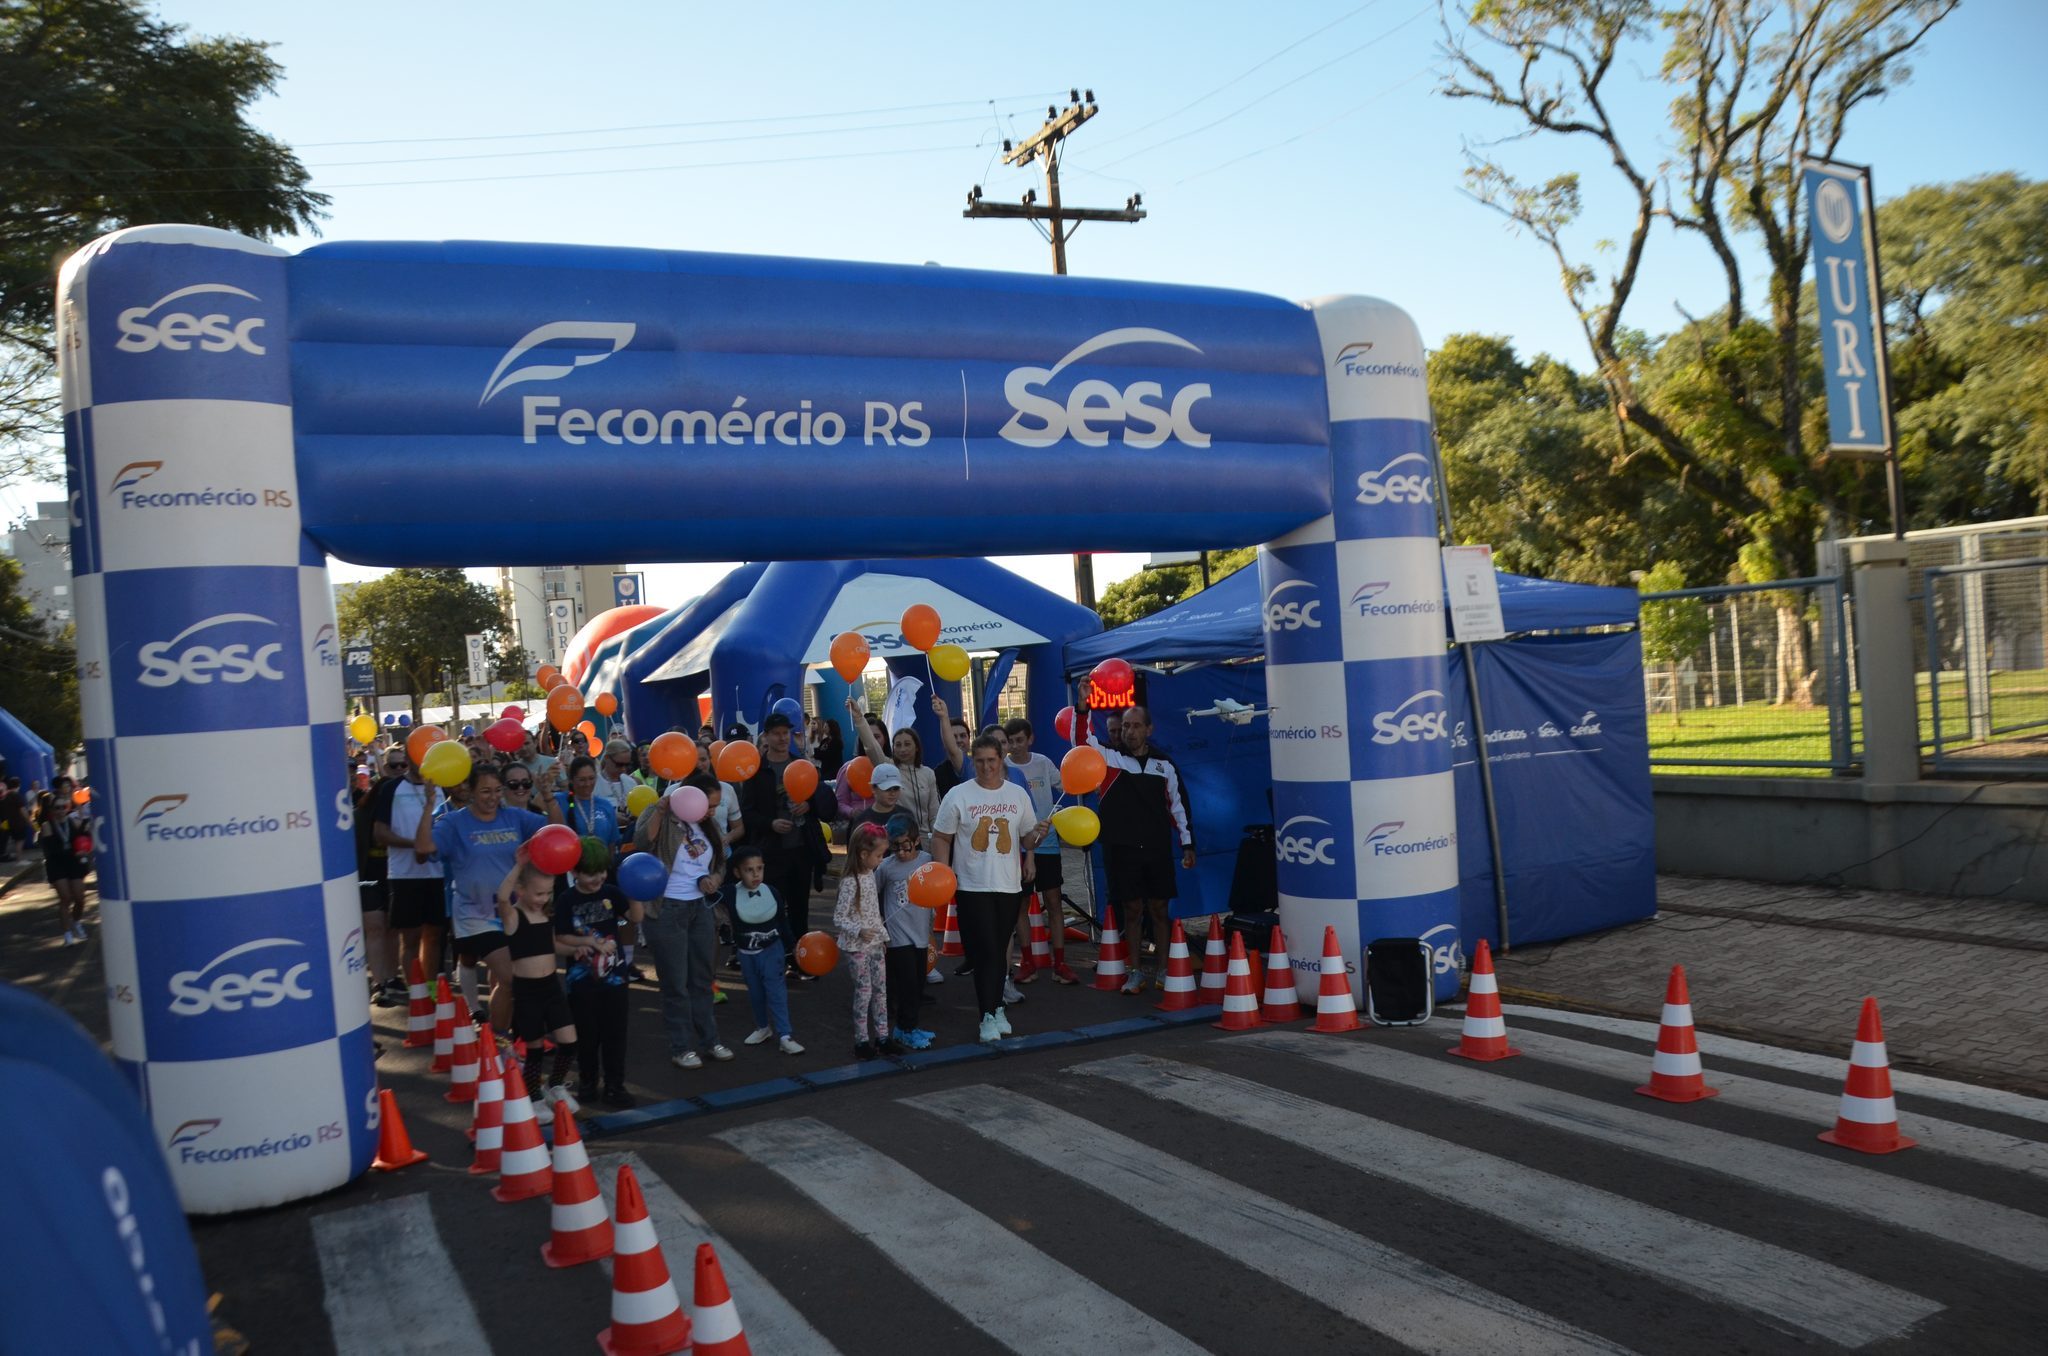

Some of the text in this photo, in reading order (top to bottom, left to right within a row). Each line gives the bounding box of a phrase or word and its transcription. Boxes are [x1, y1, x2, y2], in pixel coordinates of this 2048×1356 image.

[115, 306, 266, 355] Sesc
[1824, 255, 1866, 440] URI
[522, 396, 932, 447] Fecomércio RS
[998, 365, 1212, 449] Sesc
[121, 487, 293, 509] Fecomércio RS
[1360, 600, 1435, 616] Fecomércio
[941, 619, 1002, 635] comércio
[137, 641, 285, 687] Sesc
[471, 650, 482, 683] URI
[1321, 725, 1342, 738] RS
[146, 815, 280, 843] Fecomércio
[285, 810, 312, 830] RS
[971, 804, 1018, 818] CAPYBARAS
[1374, 834, 1449, 856] Fecomércio
[1345, 960, 1356, 974] S
[168, 961, 312, 1016] Sesc
[181, 1121, 343, 1165] Fecomércio RS
